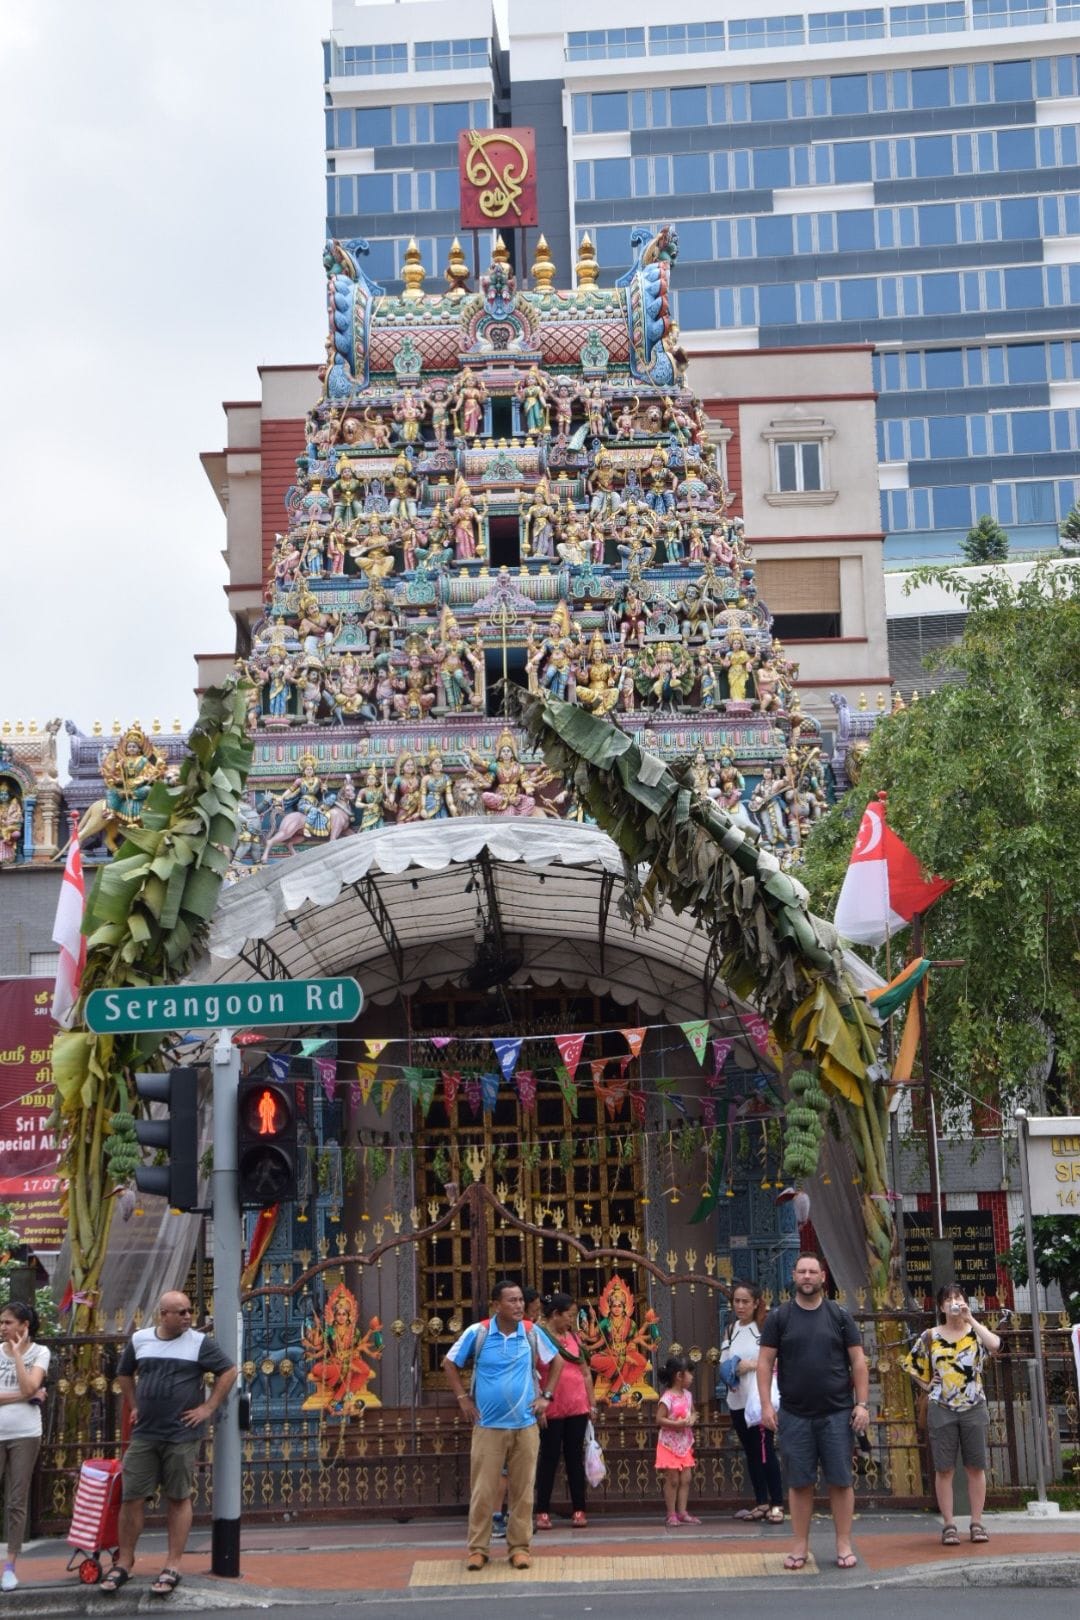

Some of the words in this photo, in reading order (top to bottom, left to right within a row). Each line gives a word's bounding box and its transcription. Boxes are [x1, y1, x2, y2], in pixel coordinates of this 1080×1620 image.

[34, 1007, 48, 1016] SRI
[104, 993, 284, 1022] Serangoon
[306, 983, 343, 1011] Rd
[16, 1116, 34, 1131] Sri
[0, 1135, 35, 1153] pecial
[1055, 1161, 1080, 1182] SR
[1056, 1189, 1080, 1207] 14
